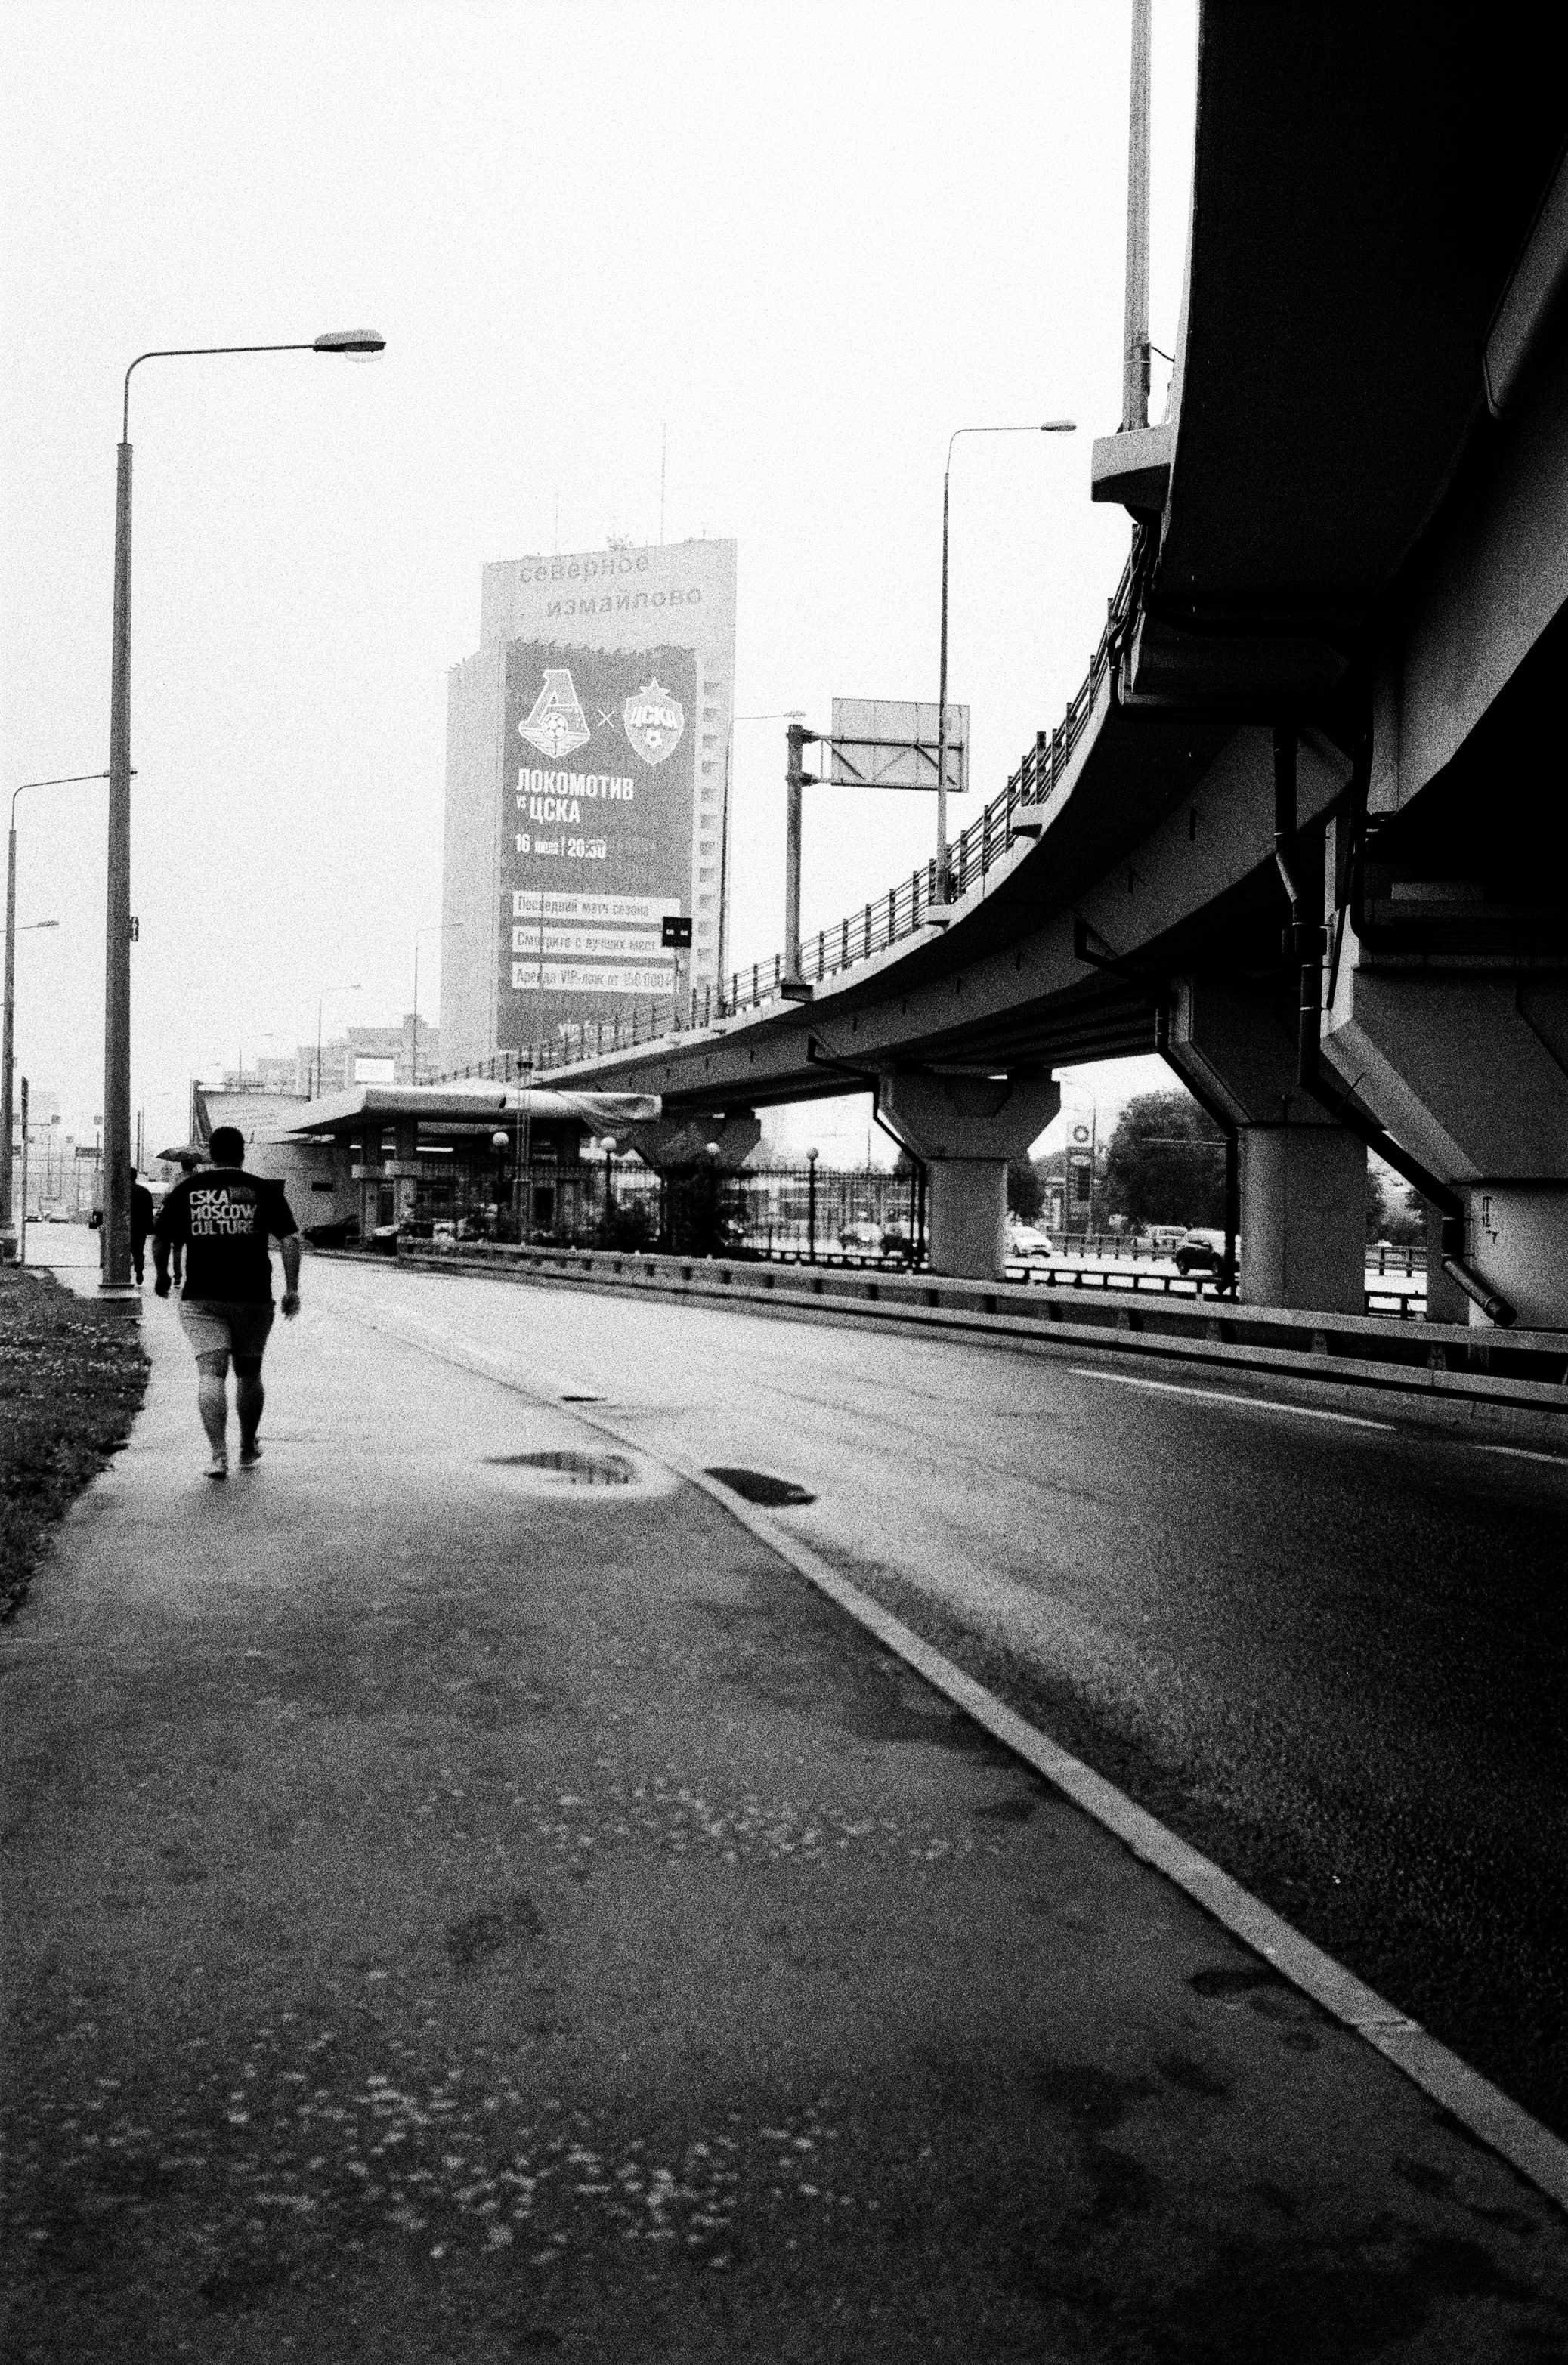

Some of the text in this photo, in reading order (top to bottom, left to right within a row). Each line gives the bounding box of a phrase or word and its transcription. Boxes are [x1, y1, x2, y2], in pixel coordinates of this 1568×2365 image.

[516, 768, 634, 800] ЛОКОМОТИВ
[530, 797, 580, 824] ЦСКА
[515, 833, 530, 853] 16
[568, 838, 607, 859] 20:30
[190, 1190, 228, 1204] CSKA
[190, 1204, 257, 1220] MOSCOW
